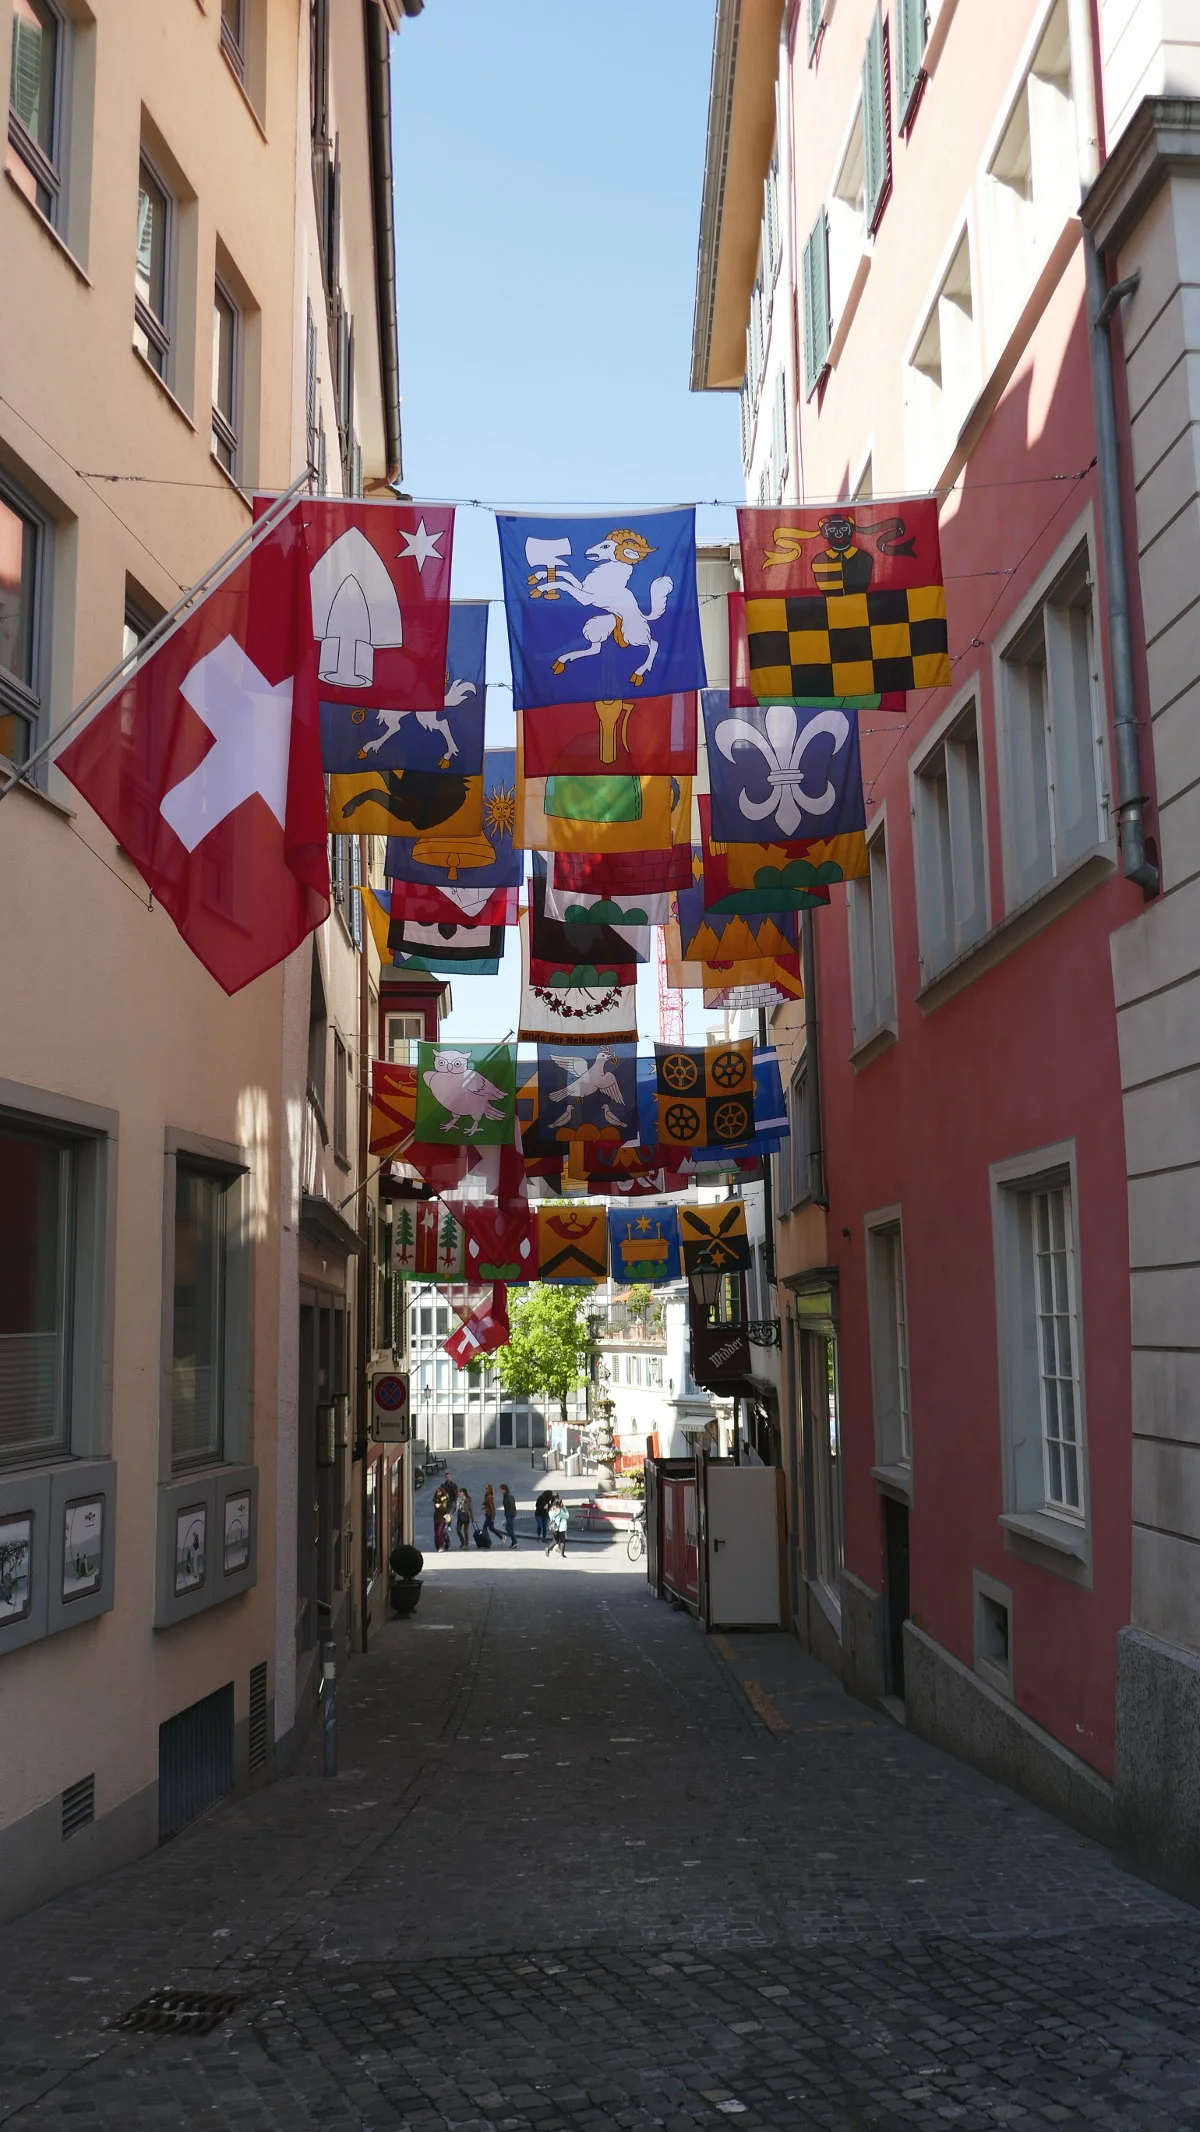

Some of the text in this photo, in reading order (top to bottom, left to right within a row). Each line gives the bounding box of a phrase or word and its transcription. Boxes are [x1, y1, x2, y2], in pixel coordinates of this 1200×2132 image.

[522, 1033, 633, 1044] Gilde der Nelkenmeister
[709, 1338, 743, 1368] Widder
